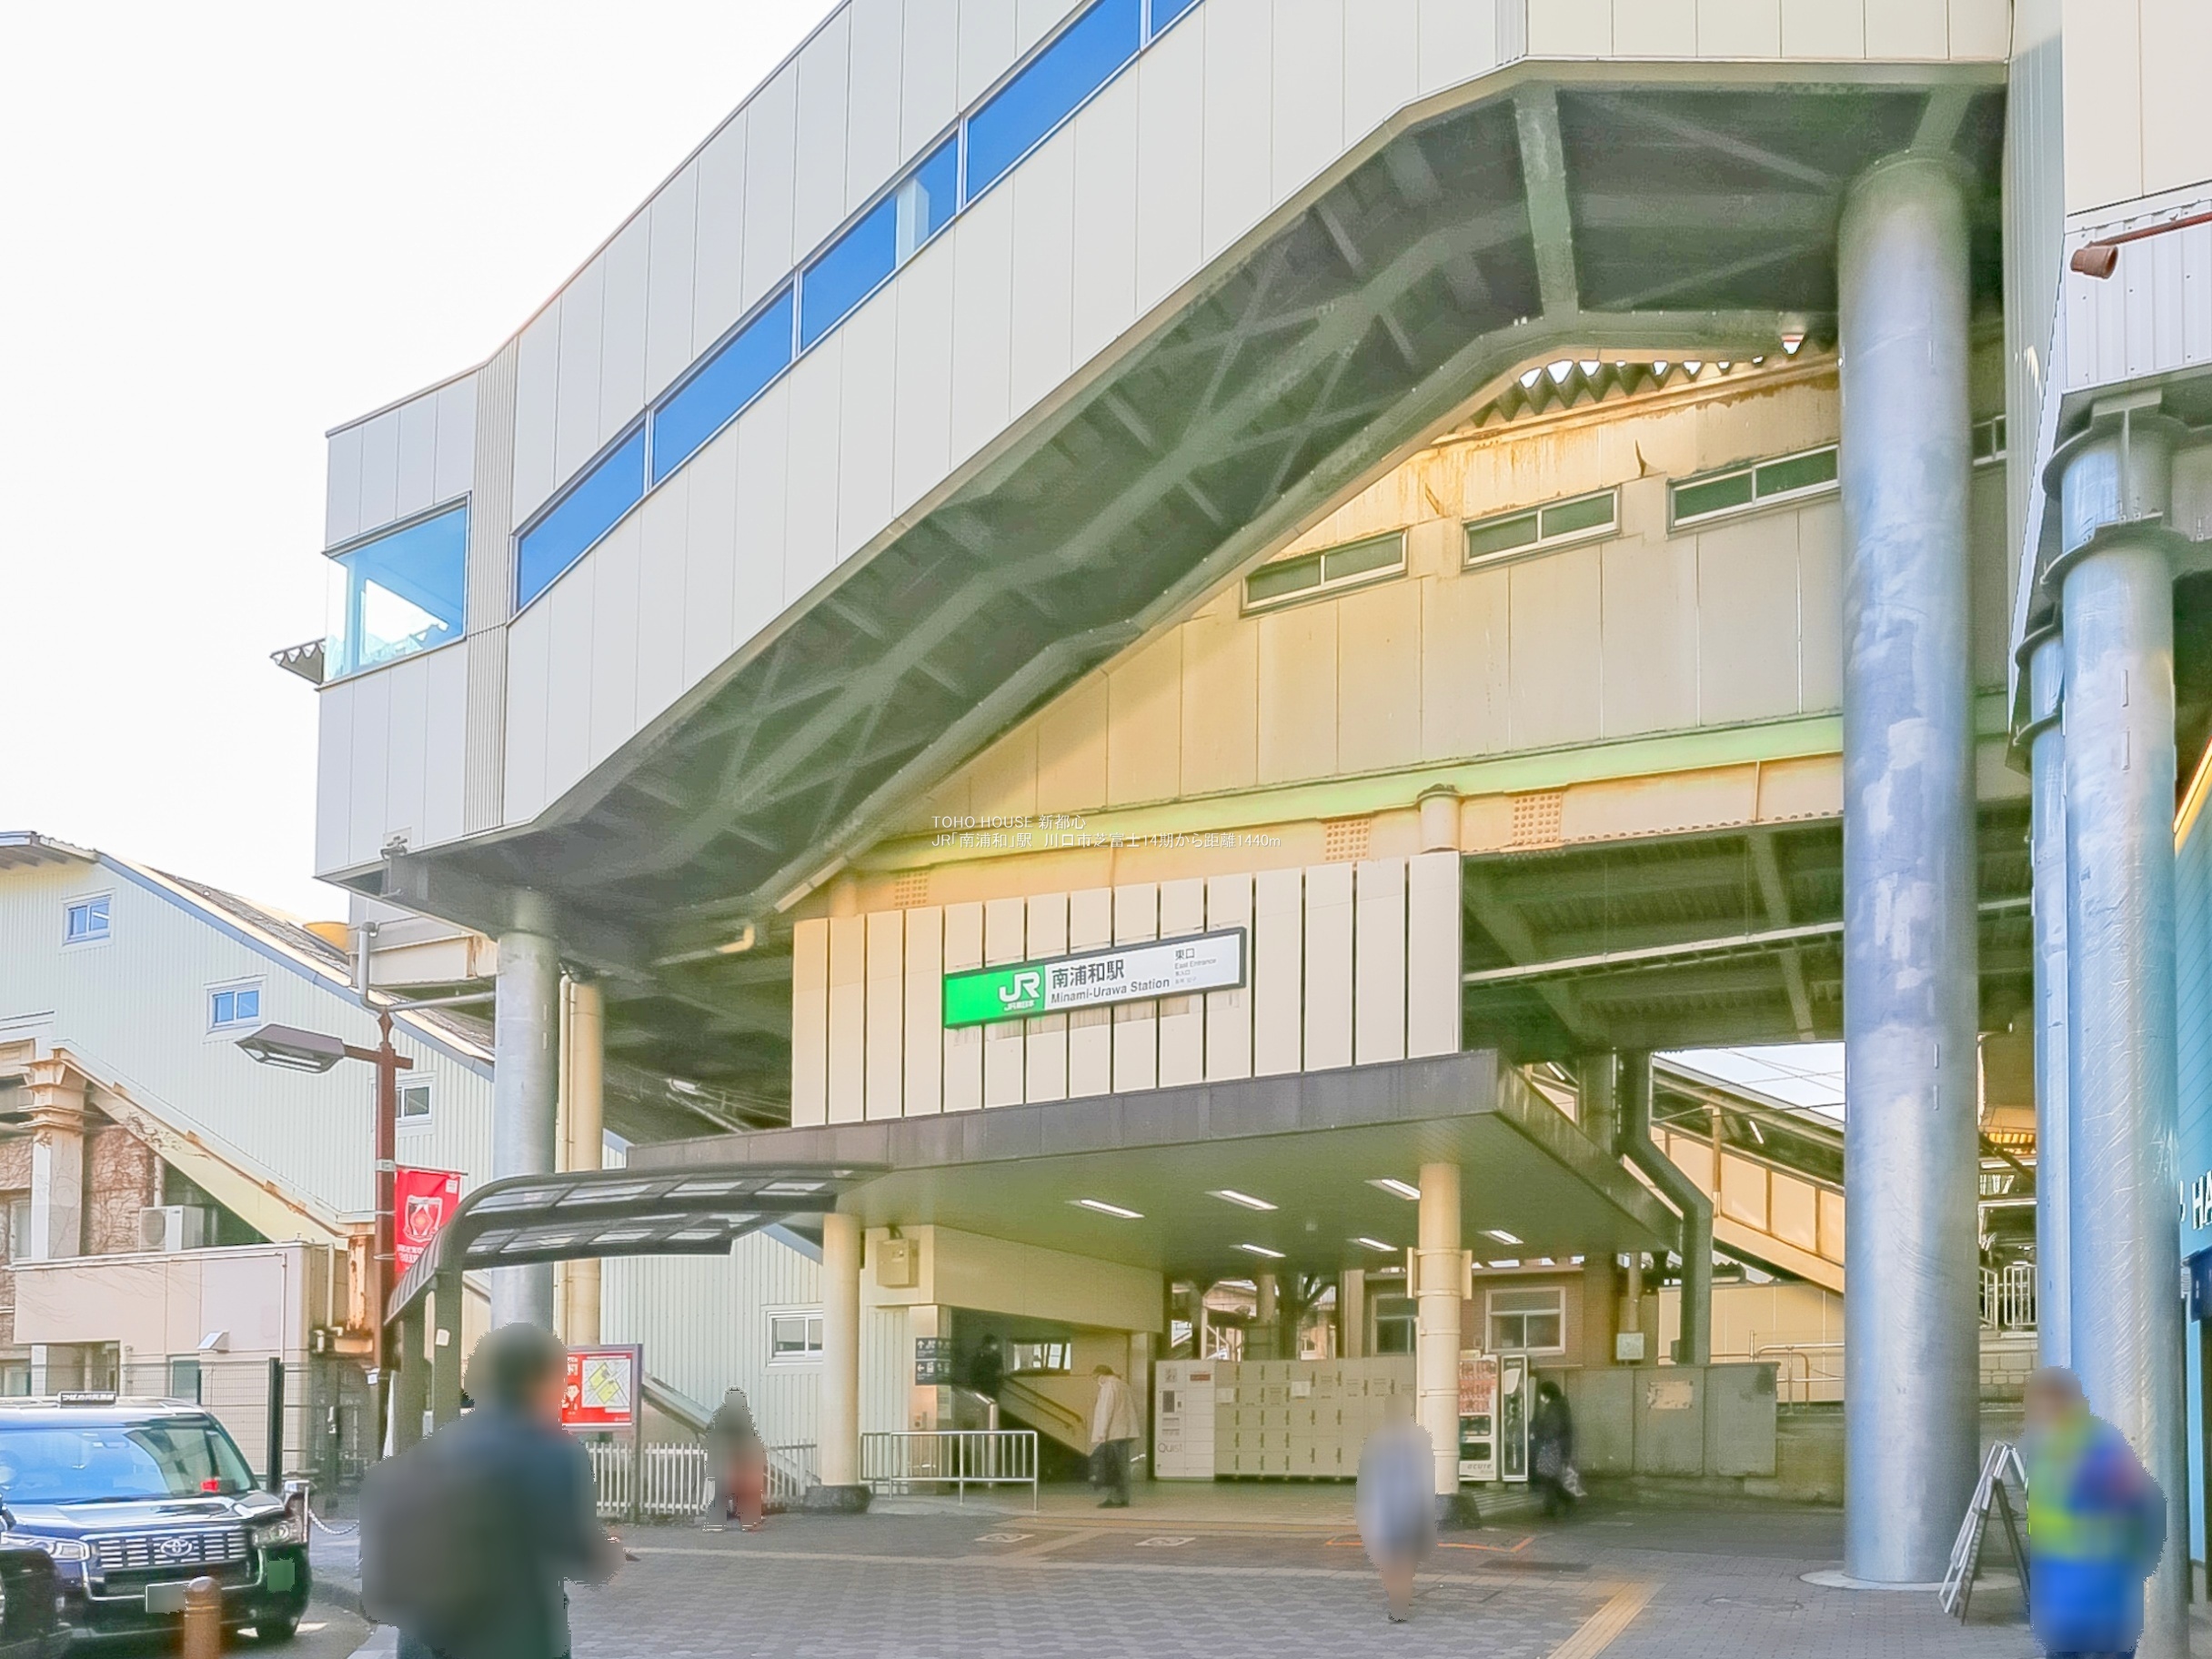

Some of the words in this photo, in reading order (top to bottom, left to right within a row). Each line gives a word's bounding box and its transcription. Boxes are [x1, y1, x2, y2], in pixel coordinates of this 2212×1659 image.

[1175, 948, 1195, 960] 東口
[999, 971, 1041, 1002] JR
[1051, 959, 1124, 990] 南浦和駅
[1051, 984, 1127, 1004] Minami-Urawa
[1131, 977, 1170, 993] Station
